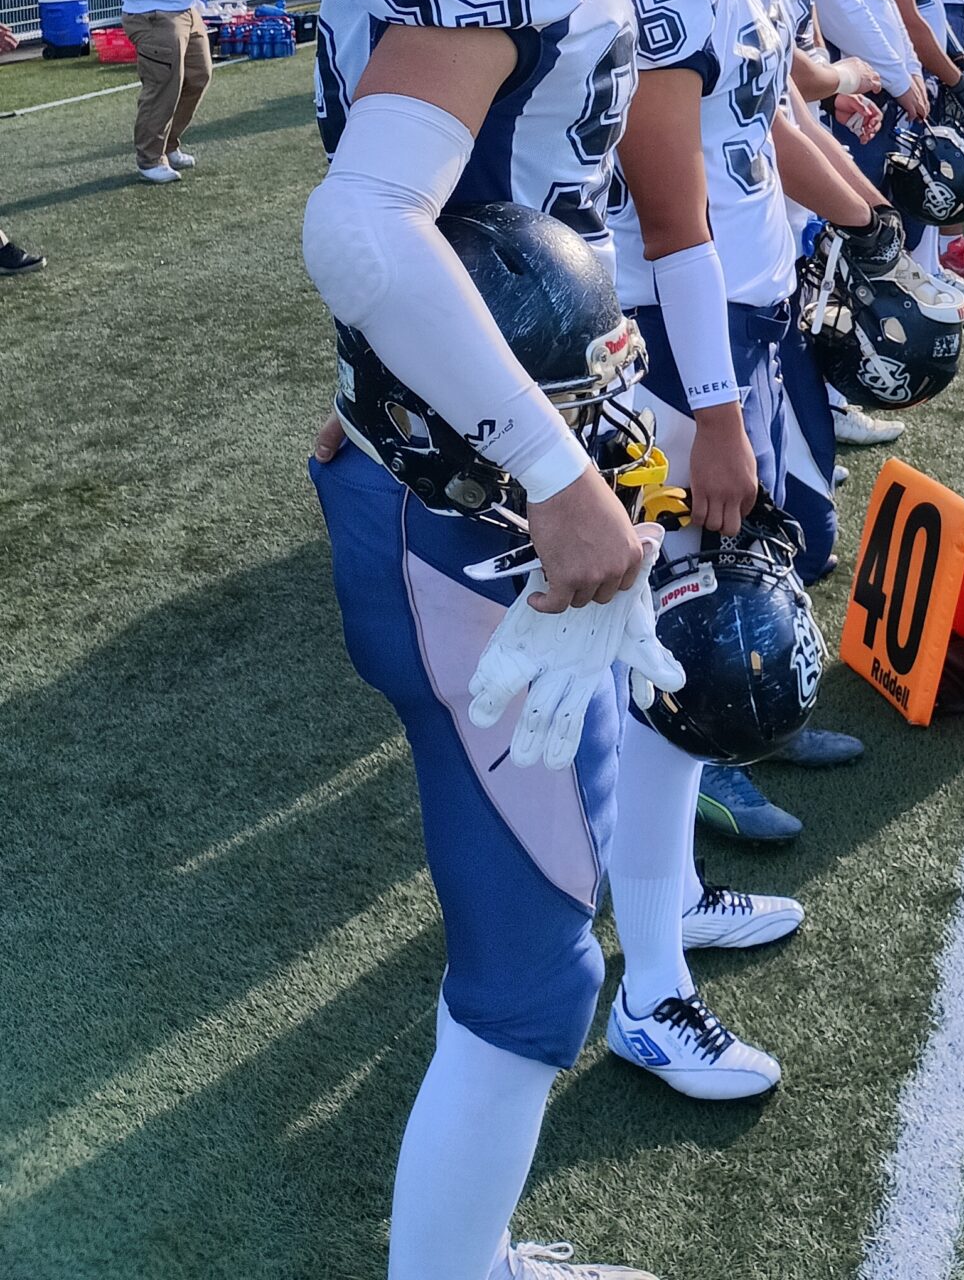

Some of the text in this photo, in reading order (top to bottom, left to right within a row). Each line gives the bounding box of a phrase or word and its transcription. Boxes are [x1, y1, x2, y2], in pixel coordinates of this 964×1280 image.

[476, 421, 514, 455] DAVID
[662, 582, 700, 608] Riddell
[853, 481, 941, 676] 40
[870, 657, 911, 712] Riddell
